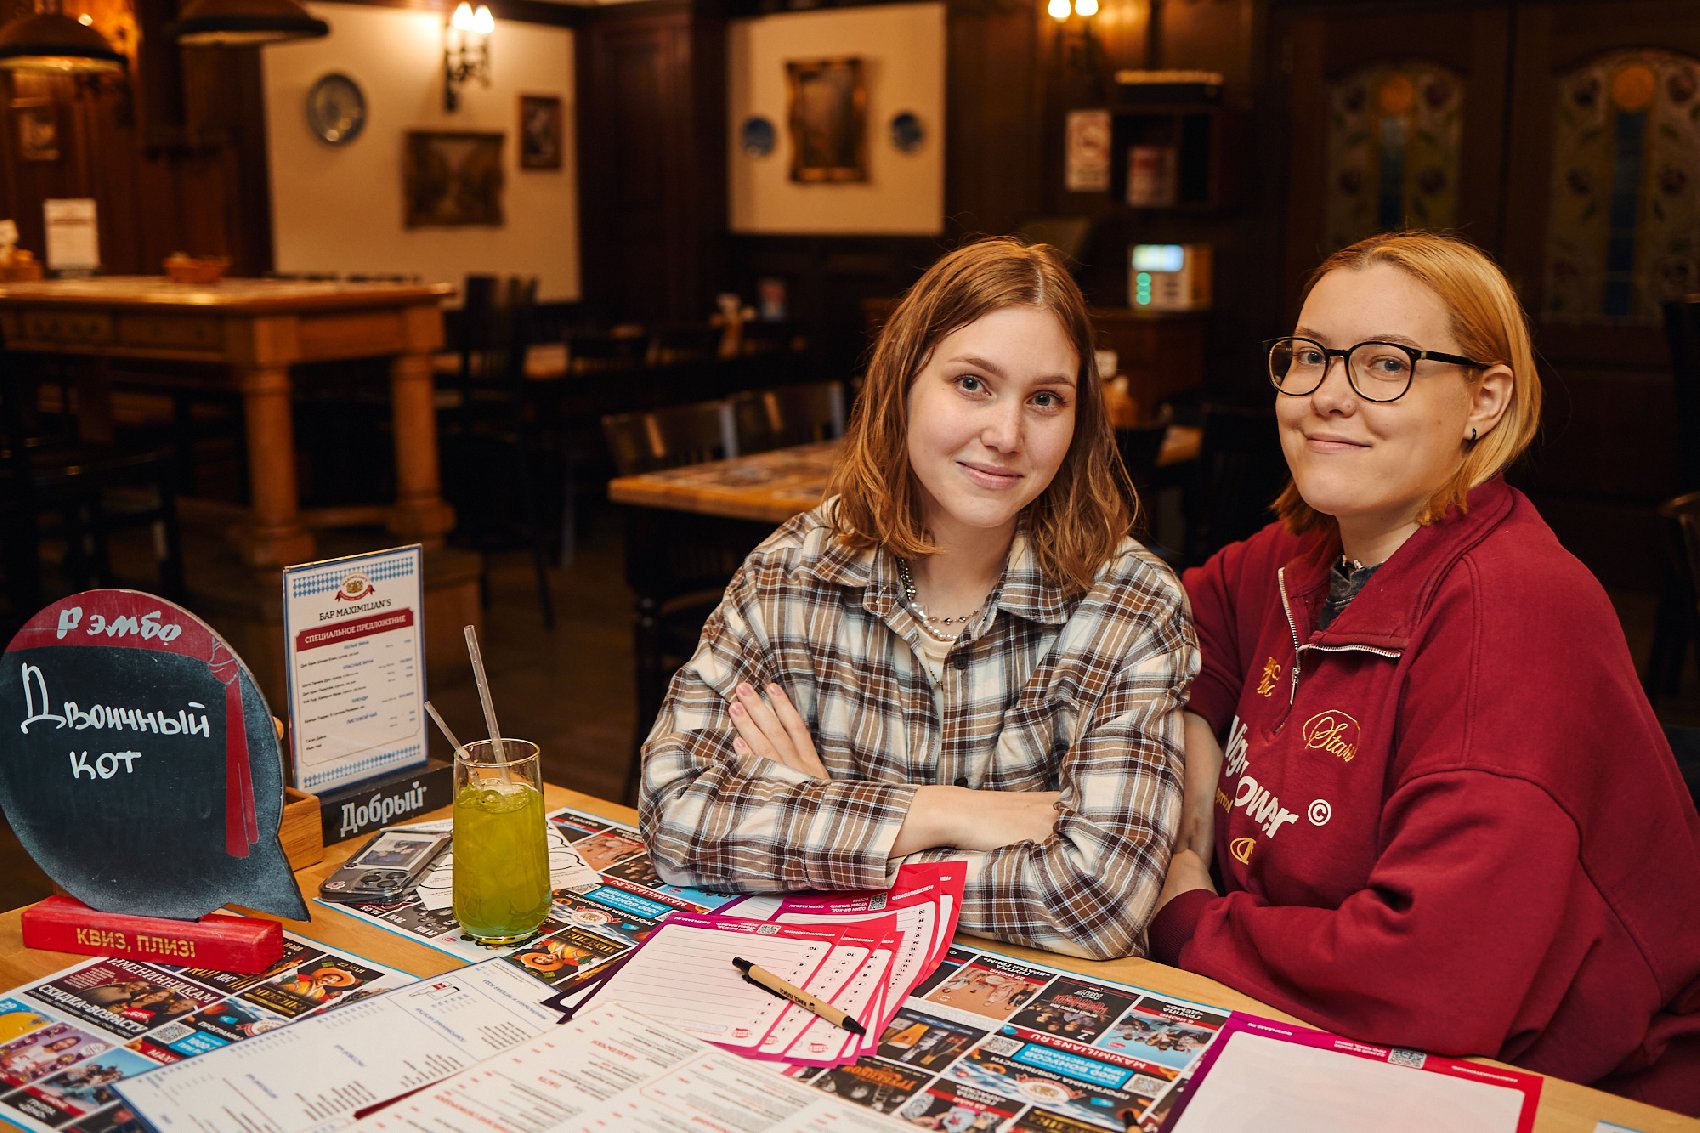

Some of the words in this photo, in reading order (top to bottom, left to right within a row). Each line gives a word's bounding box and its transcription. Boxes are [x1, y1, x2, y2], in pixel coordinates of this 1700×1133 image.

[319, 610, 336, 621] БАР
[336, 599, 392, 618] MAXIMILIAN'S
[304, 624, 356, 644] СПЕЦИАЛЬНОЕ
[356, 615, 407, 633] ПРЕДЛОЖЕНИЕ
[20, 662, 211, 738] Двоичный
[340, 781, 424, 838] Добрый
[76, 927, 132, 954] КВИЗ,
[136, 934, 196, 959] ПЛИЗ!
[107, 957, 220, 1003] ИМЕНИННИКАМ
[1030, 1033, 1146, 1070] MAXIMILIANS.RU
